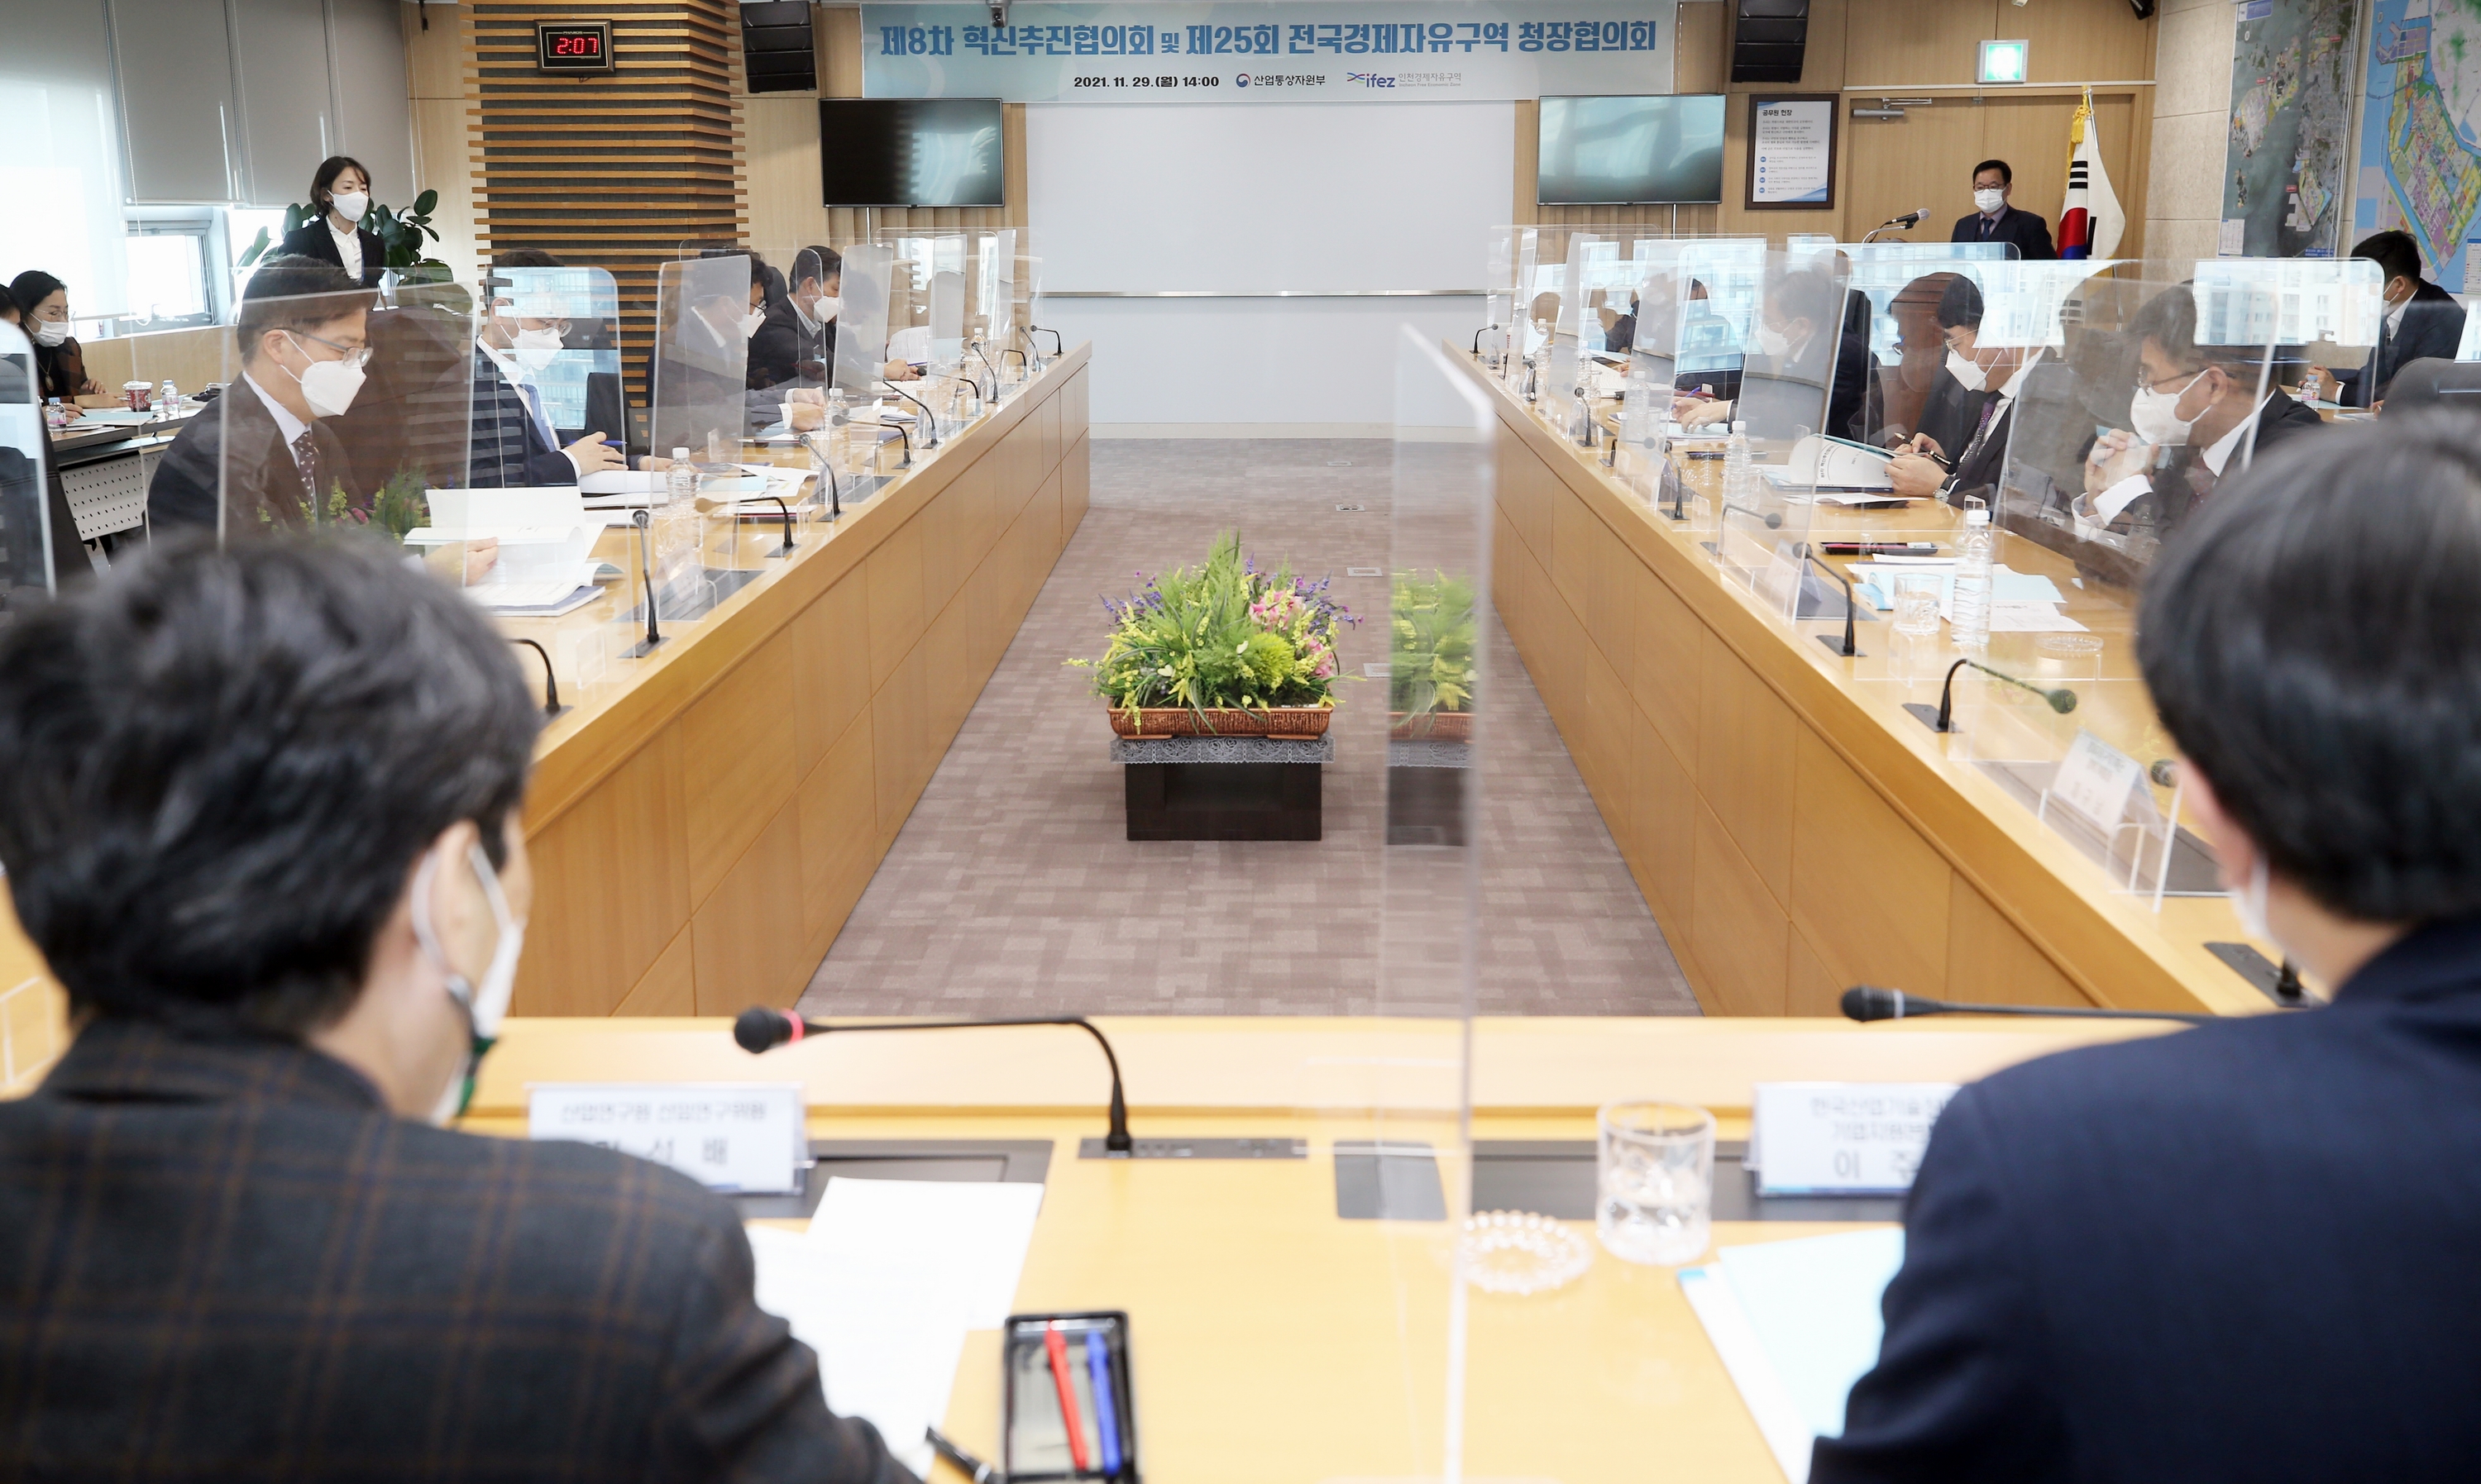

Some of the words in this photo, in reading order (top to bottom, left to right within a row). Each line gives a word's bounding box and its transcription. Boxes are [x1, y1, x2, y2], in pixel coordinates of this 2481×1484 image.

[880, 25, 954, 56] 제8차
[963, 24, 1154, 56] 혁신추진협의회
[1160, 32, 1179, 54] 및
[1186, 24, 1279, 55] 제25회
[1288, 22, 1509, 55] 전국경제자유구역
[1518, 21, 1656, 52] 청장협의회
[557, 37, 598, 55] 2:07
[1074, 77, 1110, 88] 2021.
[1113, 77, 1128, 88] 11.
[1182, 76, 1220, 88] 14:00
[1254, 74, 1326, 86] 산업통상자원부
[1366, 74, 1396, 88] ifez
[1398, 73, 1461, 82] 인천경제자유구역
